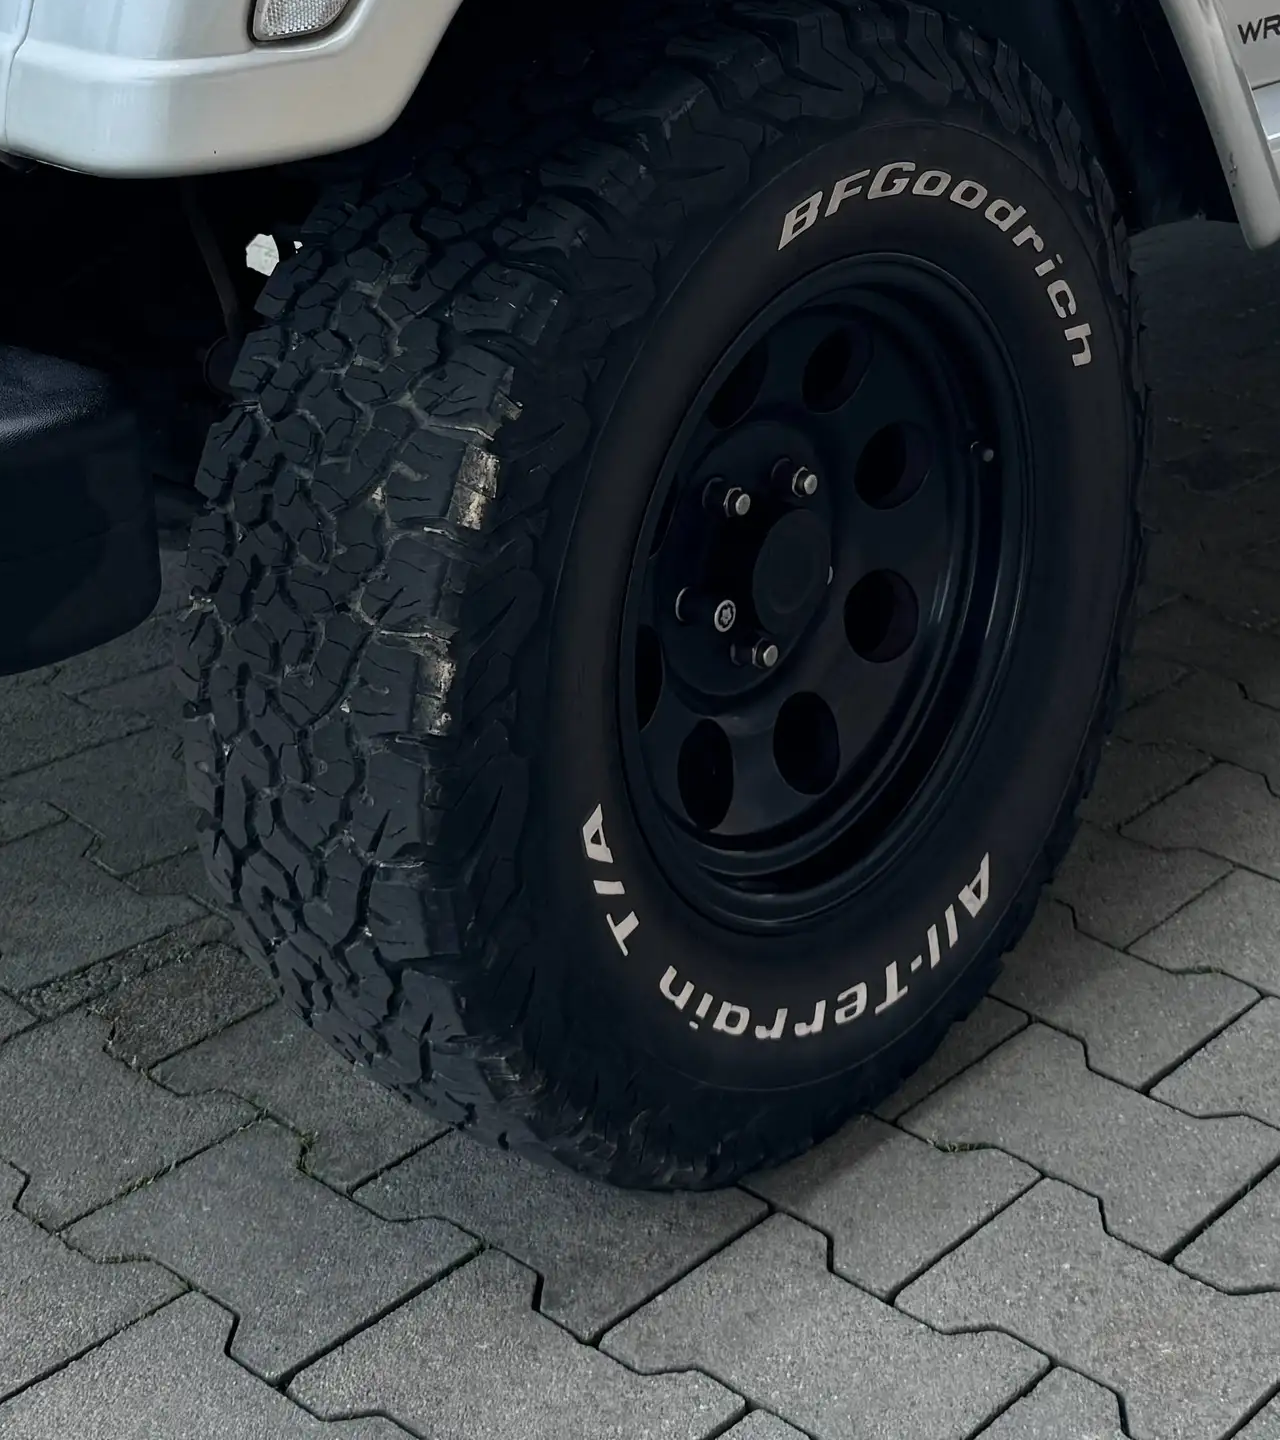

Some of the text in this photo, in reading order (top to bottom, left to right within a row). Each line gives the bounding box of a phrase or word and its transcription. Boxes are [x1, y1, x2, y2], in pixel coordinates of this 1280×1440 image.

[777, 160, 1093, 367] BFGoodrich
[580, 802, 992, 1039] All-Terrain T/A
